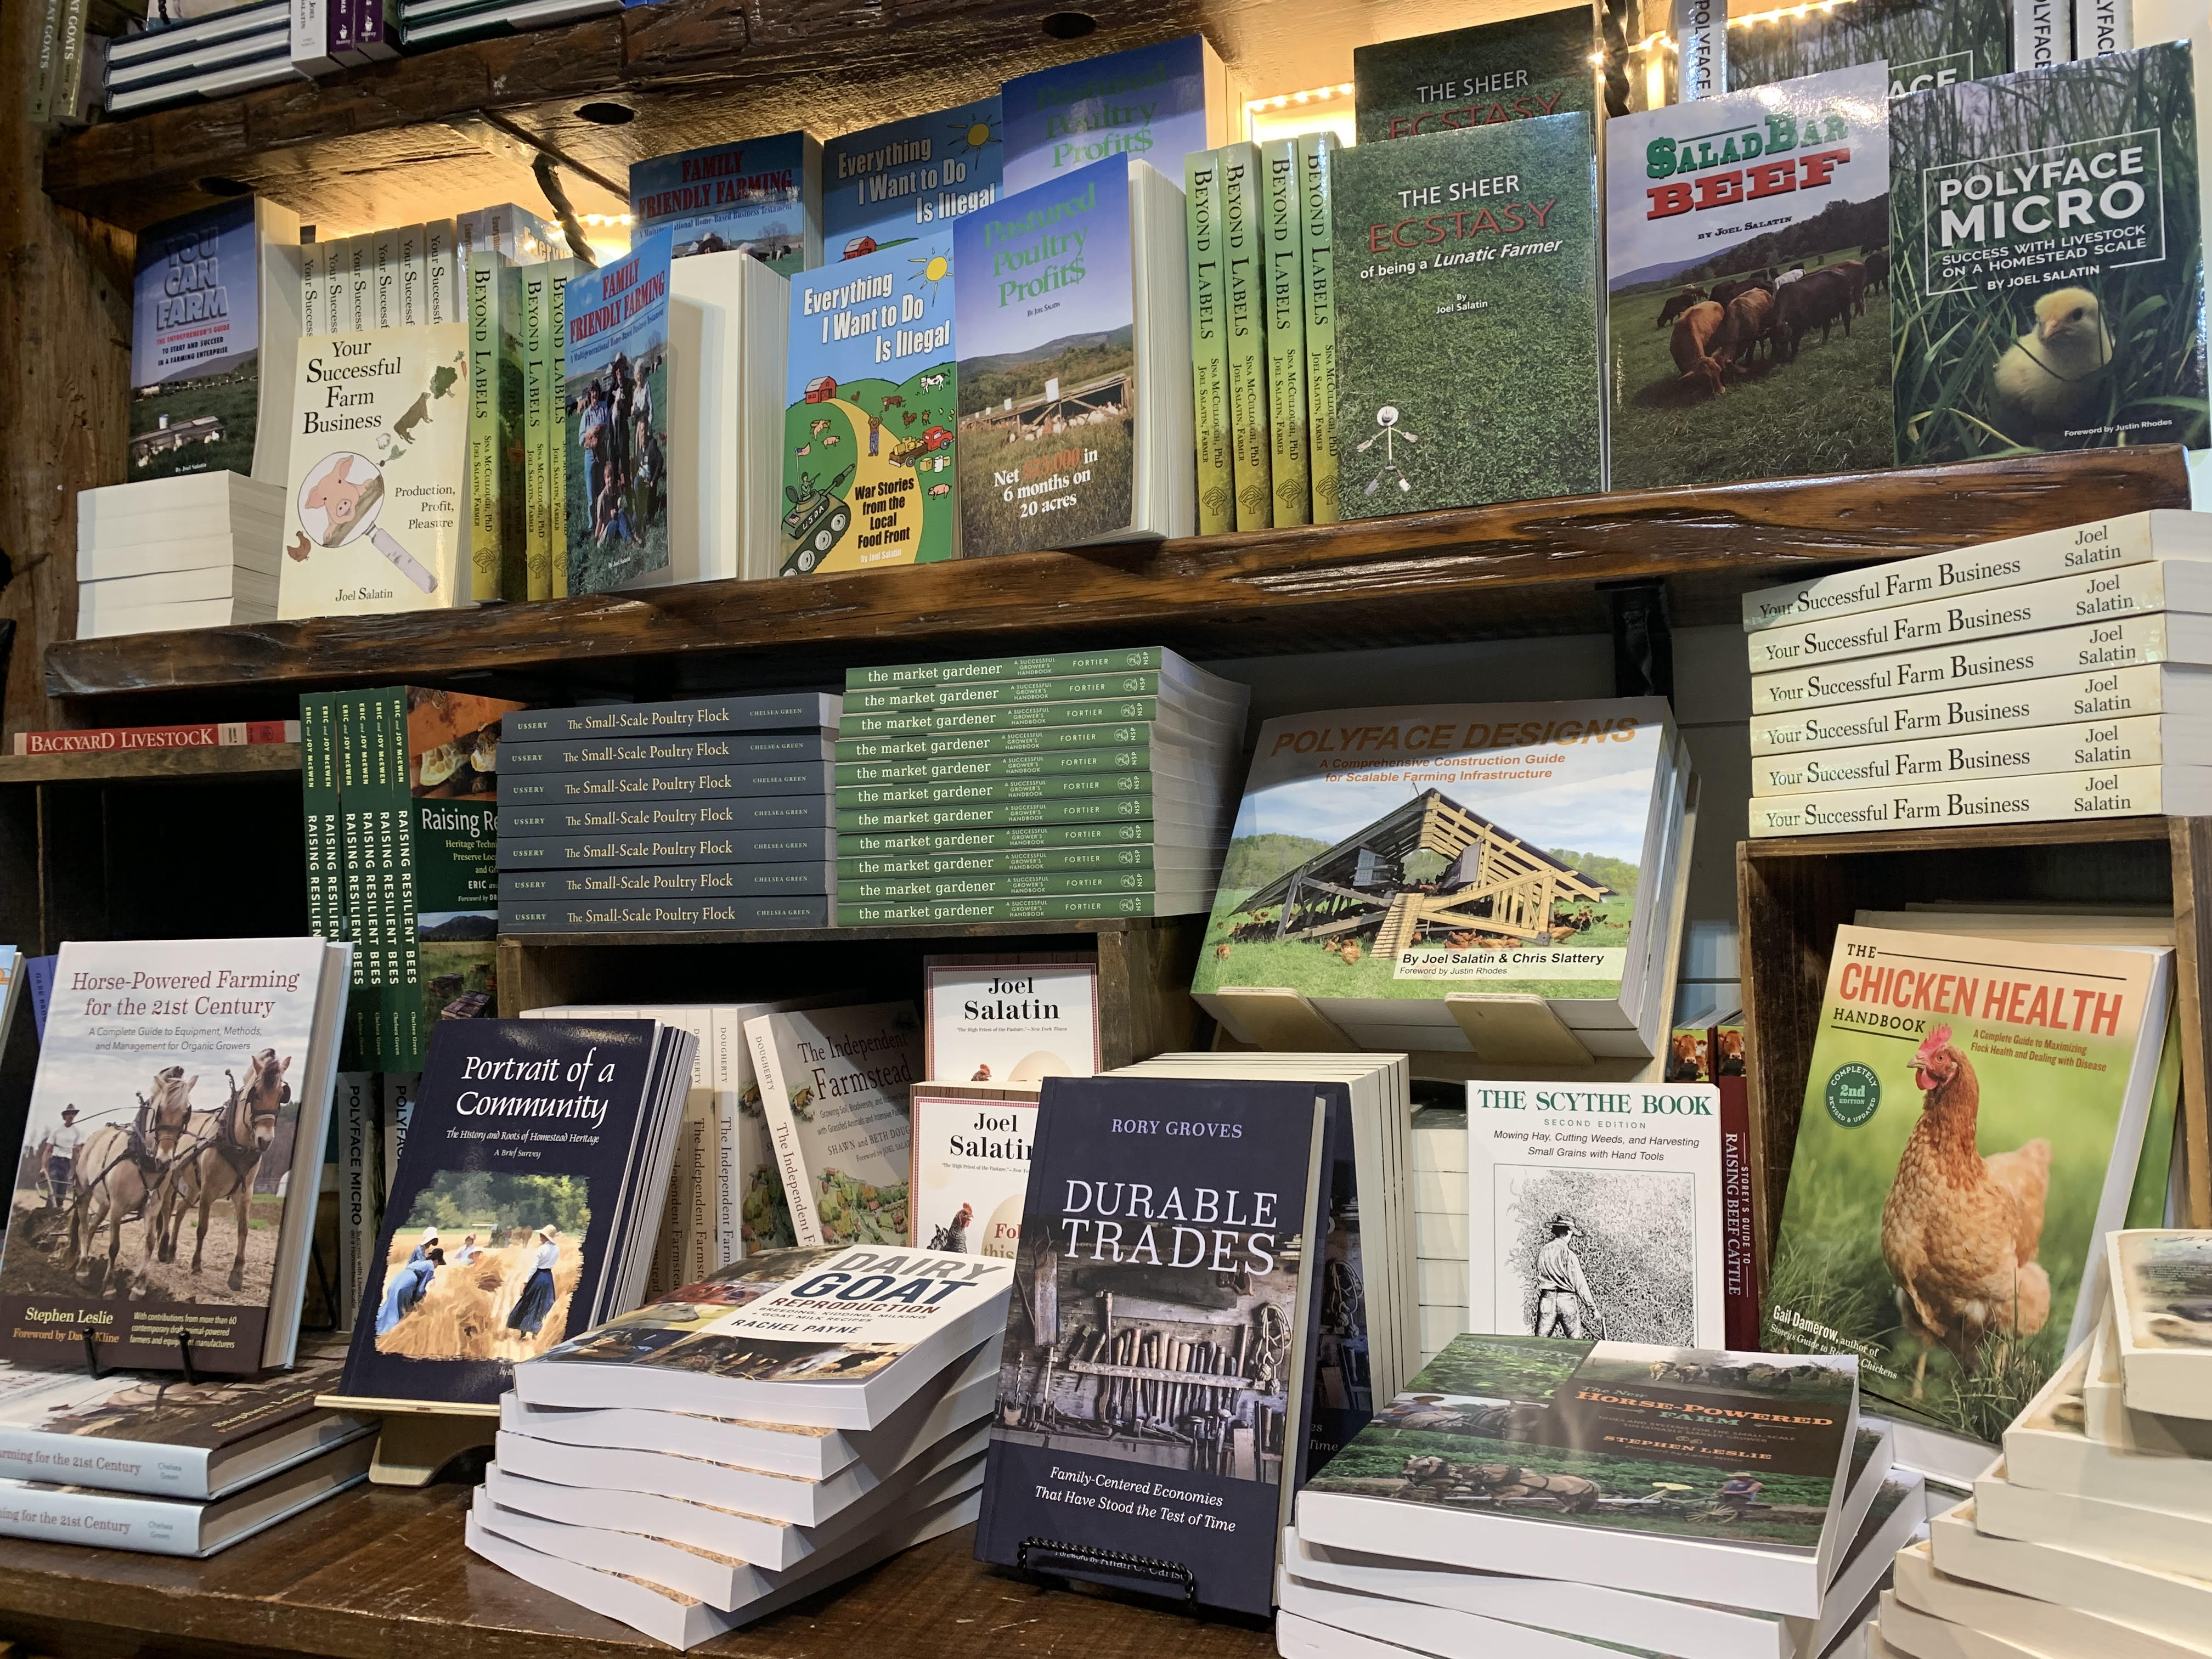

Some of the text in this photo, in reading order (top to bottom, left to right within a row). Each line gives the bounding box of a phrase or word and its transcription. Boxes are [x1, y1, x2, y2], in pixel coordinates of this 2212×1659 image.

[1646, 147, 1850, 220] BEEF
[1940, 146, 2145, 206] POLYFACE
[1398, 174, 1520, 208] THE SHEER
[1370, 199, 1556, 253] ECSTASY
[1941, 180, 2146, 247] MICRO
[167, 227, 218, 265] YOU
[993, 227, 1088, 276] Poultry
[1942, 224, 2146, 266] SUCCESS WITH LIVESTOCK
[1360, 239, 1563, 279] of being a Lunatic Farmer
[165, 257, 218, 297] CAN
[602, 257, 640, 301] FAMILY
[804, 273, 893, 316] Everything
[1436, 300, 1488, 314] Joel Salatin
[1457, 293, 1467, 303] By
[157, 286, 228, 330] FARM
[570, 270, 666, 345] FRIENDLY FARMING
[822, 296, 924, 343] I Want to Do
[331, 340, 371, 358] Your
[876, 319, 950, 363] Is Illegal
[307, 358, 400, 383] Successful
[326, 386, 374, 408] Farm
[303, 411, 382, 435] Business
[2064, 418, 2172, 437] Foreword by Justin Rhodes
[395, 485, 455, 497] Production,
[855, 477, 915, 500] War Stories
[1004, 470, 1091, 501] 6 months on
[421, 500, 454, 512] Profit,
[802, 505, 825, 531] USDA
[862, 496, 905, 516] from the
[1020, 494, 1077, 518] 20 acres
[408, 518, 453, 529] Pleasure
[870, 512, 896, 531] Local
[858, 527, 910, 549] Food Front
[335, 588, 393, 601] Joel Salatin
[1760, 558, 2022, 620] Your Successful Farm Business
[868, 663, 1002, 682] the market gardener
[1073, 658, 1109, 667] FORTIER
[518, 708, 730, 730] USSERY The Small-Scale Poultry Flock
[31, 732, 115, 752] BACKYARD
[121, 728, 213, 748] LIVESTOCK
[1270, 717, 1639, 757] POLYFACE DESIGNS
[1320, 752, 1566, 770] A Comprehensive Construction Guide
[398, 810, 417, 983] RAISING RESILIENT BEES
[1402, 951, 1605, 966] By Joel Salatin & Chris Slattery
[1847, 943, 1877, 958] THE
[72, 970, 300, 992] Horse-Powered Farming
[988, 977, 1034, 995] Joel
[84, 996, 276, 1018] for the 21st Century
[963, 1000, 1060, 1020] Salatin
[1838, 963, 2123, 1036] CHICKEN HEALTH
[1833, 1008, 1926, 1034] HANDBOOK
[798, 1043, 826, 1063] The
[461, 1047, 616, 1092] Portrait of a
[812, 1054, 913, 1100] Farmstead
[1831, 1066, 1877, 1086] COMPLETELY
[1478, 1090, 1713, 1116] THE SCYTHE BOOK
[1840, 1085, 1865, 1097] 2nd
[456, 1091, 608, 1130] Community
[447, 1127, 600, 1144] The History and Roots of Homestead Heritage
[1111, 1119, 1243, 1138] RORY GROVES
[1494, 1131, 1700, 1148] Mowing Hay, Cutting Weeds, and Harvesting
[349, 1085, 362, 1225] POLYFACE MICRO
[1063, 1180, 1278, 1228] DURABLE
[1726, 1133, 1741, 1295] RAISING BEEF CATTLE
[1062, 1218, 1276, 1276] TRADES
[827, 1253, 1007, 1280] DAIRY
[791, 1273, 978, 1305] GOAT
[25, 1307, 114, 1325] Stephen Leslie
[769, 1297, 941, 1314] REPRODUCTION
[731, 1319, 862, 1334] RACHEL PAYNE
[1773, 1305, 1880, 1357] Gail Damerow, author of
[1658, 1412, 1740, 1426] FARM
[1602, 1435, 1695, 1451] STEPHEN
[1700, 1447, 1772, 1460] LESLIE
[1050, 1466, 1223, 1506] Family-Centered Economies
[1035, 1486, 1237, 1532] That Have Stood the Test of Time
